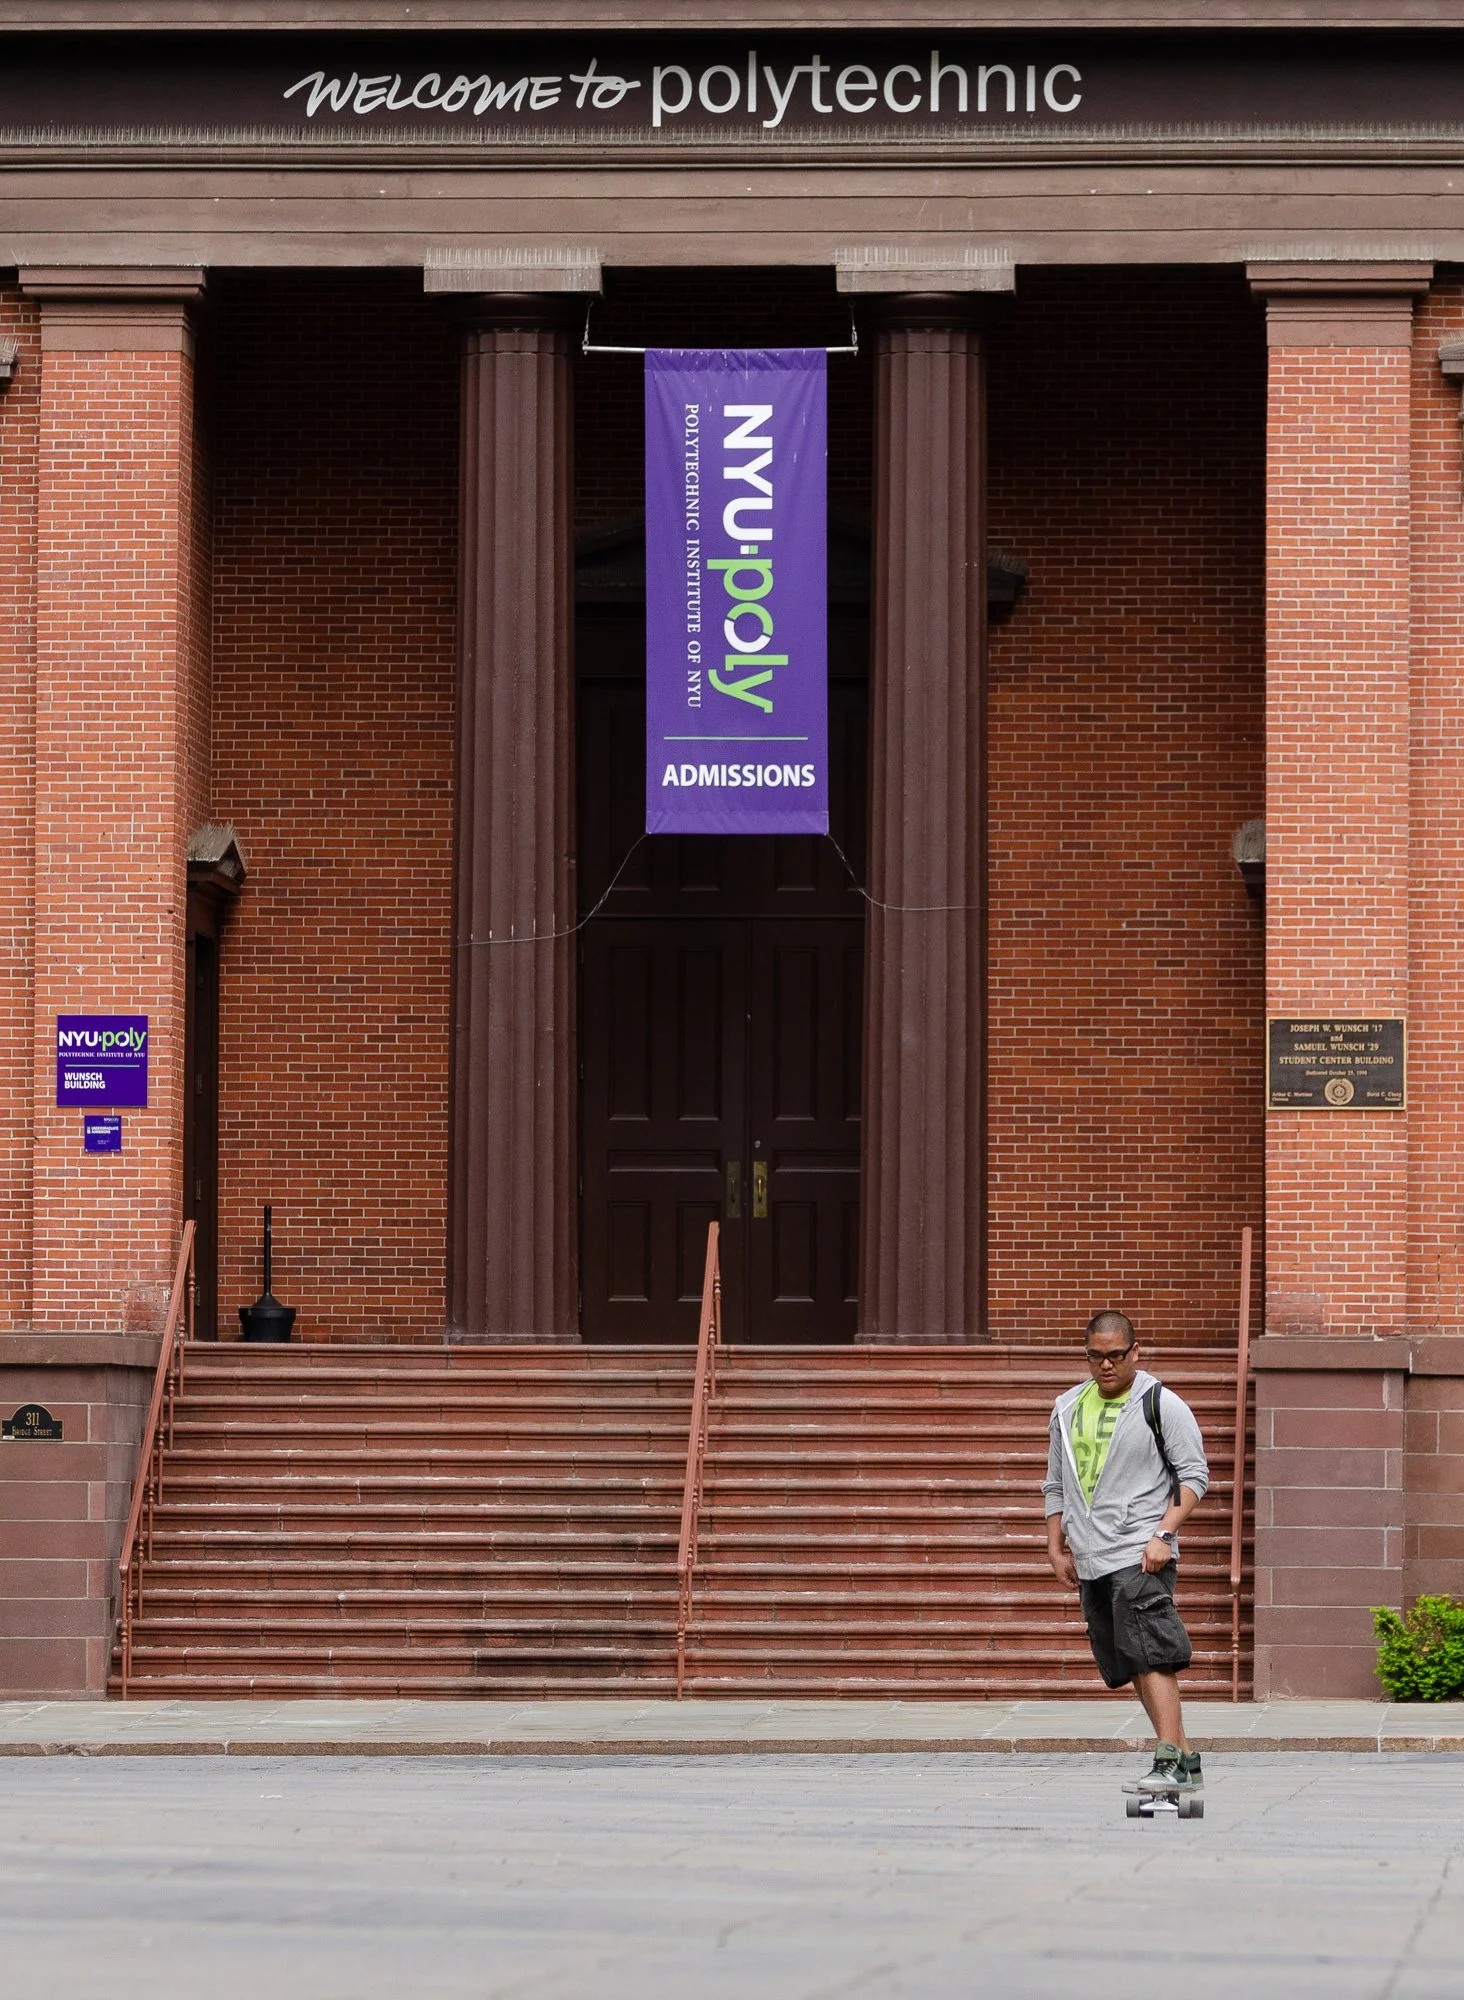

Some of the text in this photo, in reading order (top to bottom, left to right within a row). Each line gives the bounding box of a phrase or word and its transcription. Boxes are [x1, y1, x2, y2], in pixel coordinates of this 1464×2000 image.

[283, 50, 1084, 129] WELCOME to polytechnic
[684, 403, 702, 709] POLYTECHNIC INSTITUTE OF NYU
[661, 763, 816, 788] ADMISSIONS
[1290, 1024, 1320, 1033] JOSEPH
[1322, 1024, 1332, 1033] W.
[1334, 1024, 1369, 1033] WUNSCH
[1330, 1034, 1344, 1042] and
[1294, 1043, 1327, 1051] SAMUEL
[1330, 1043, 1365, 1051] WUNSCH
[1279, 1056, 1394, 1065] STUDENT CENTER BUILDING
[64, 1072, 103, 1081] WUNSCH
[64, 1081, 106, 1089] BUILDING
[25, 1412, 40, 1426] 311
